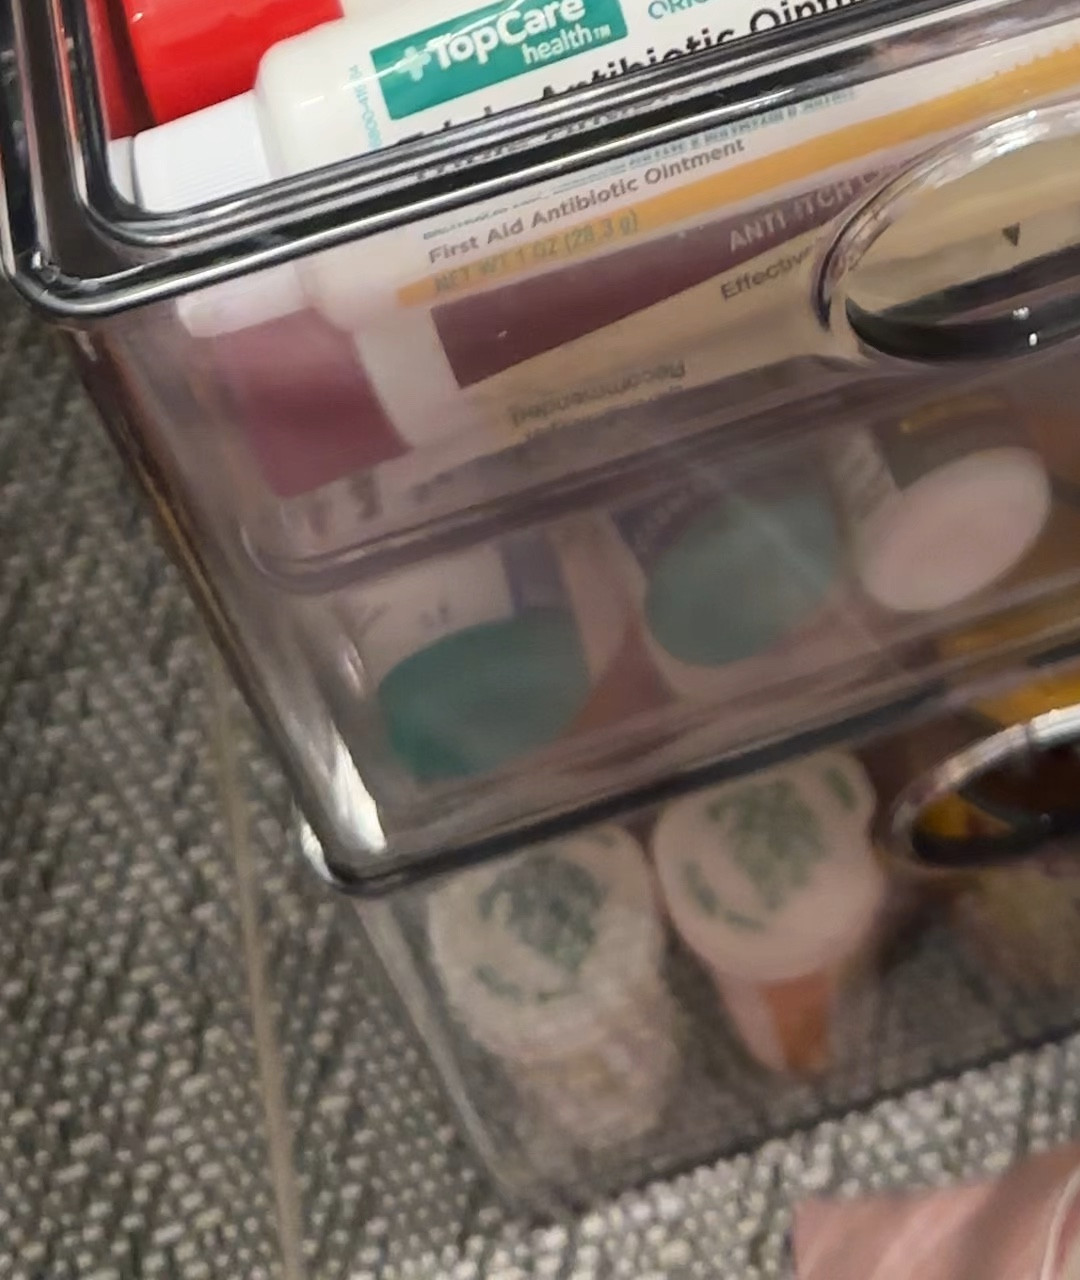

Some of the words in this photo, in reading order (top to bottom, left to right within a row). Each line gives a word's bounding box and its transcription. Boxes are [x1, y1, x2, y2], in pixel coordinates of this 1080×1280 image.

[427, 233, 479, 263] First
[483, 216, 525, 243] Aid
[526, 174, 640, 228] Antibiotic
[643, 139, 746, 185] Ointment
